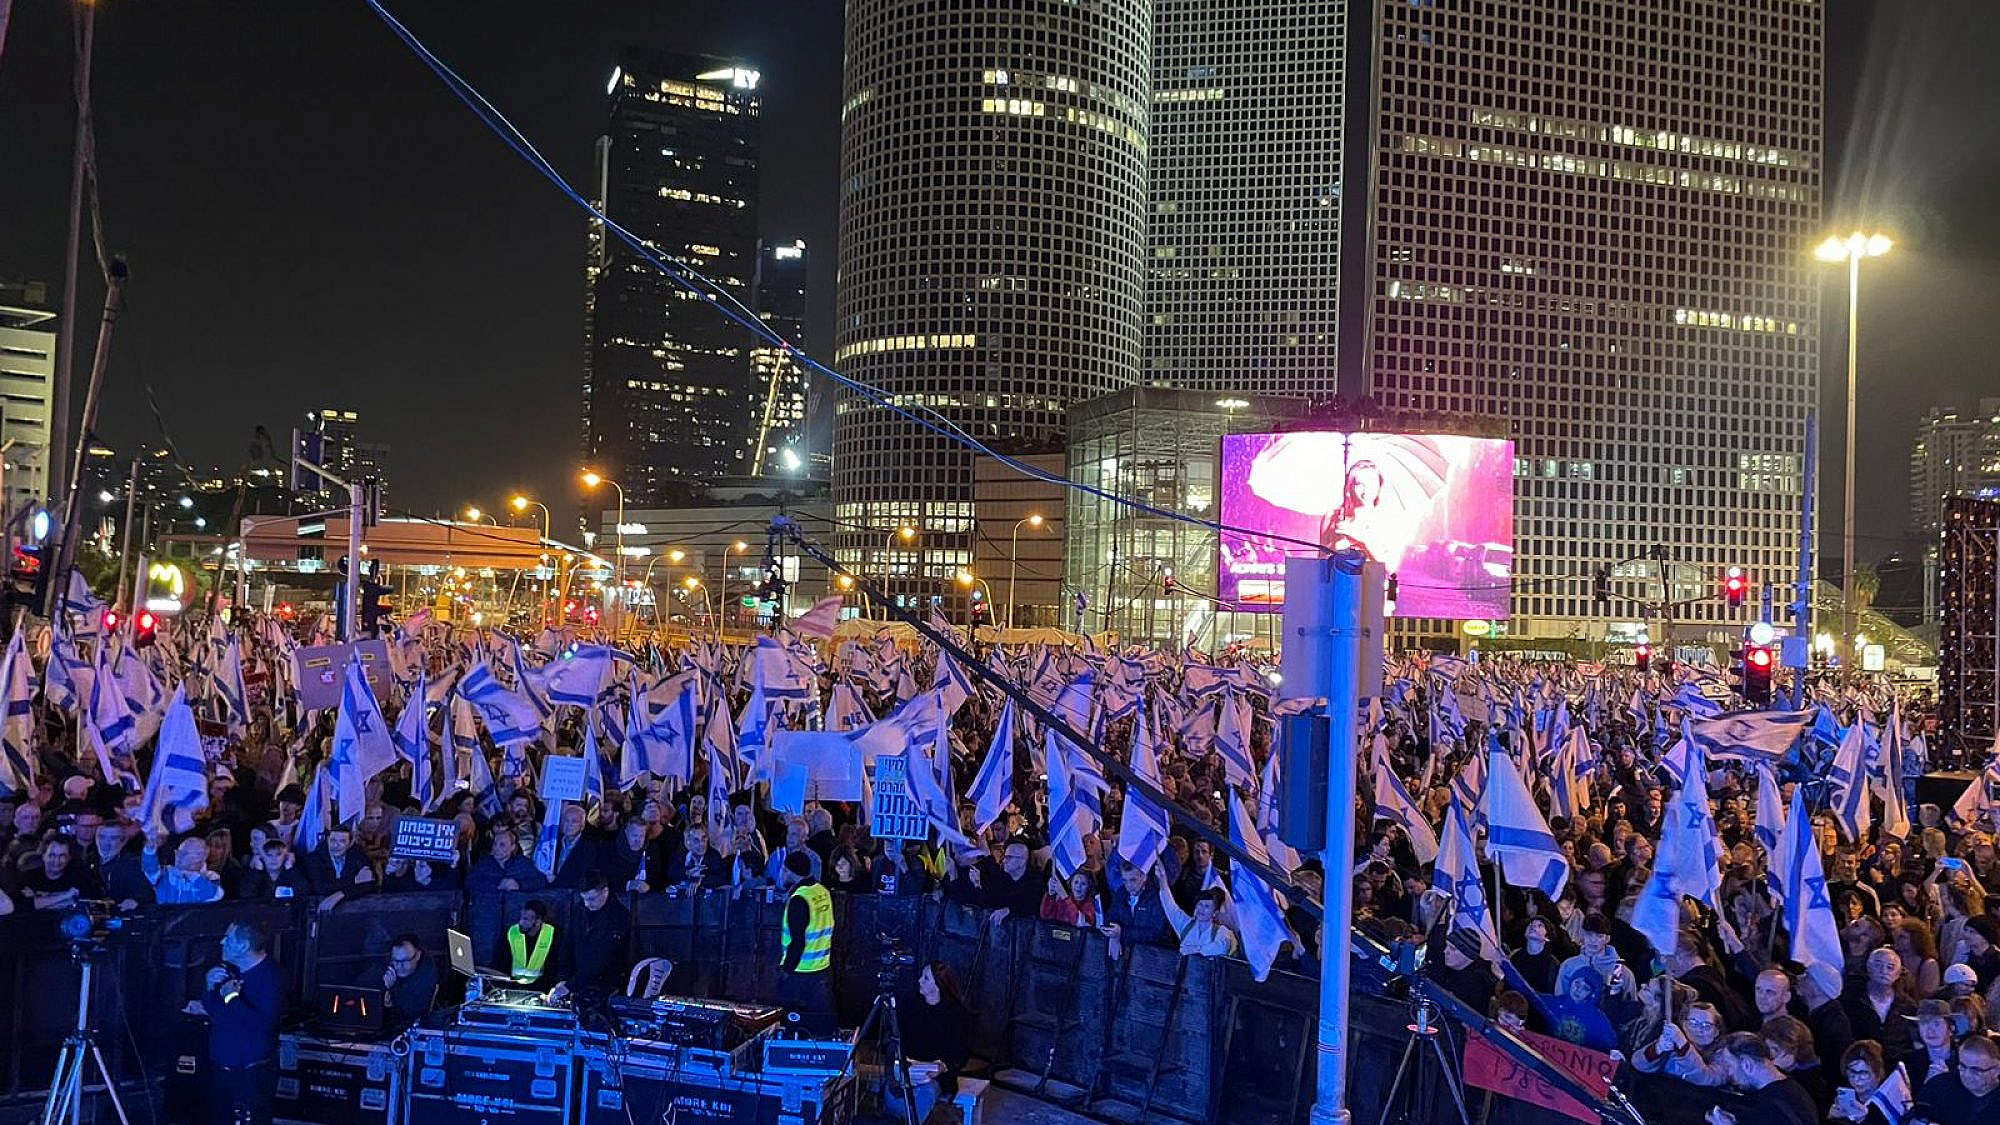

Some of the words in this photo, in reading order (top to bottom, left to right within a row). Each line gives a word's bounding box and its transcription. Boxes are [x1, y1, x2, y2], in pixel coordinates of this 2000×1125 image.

[734, 67, 760, 89] EY
[398, 820, 435, 835] בטחון
[436, 823, 456, 837] אין
[397, 834, 433, 847] כיבוש
[434, 838, 454, 850] עם
[673, 1095, 708, 1109] MORE
